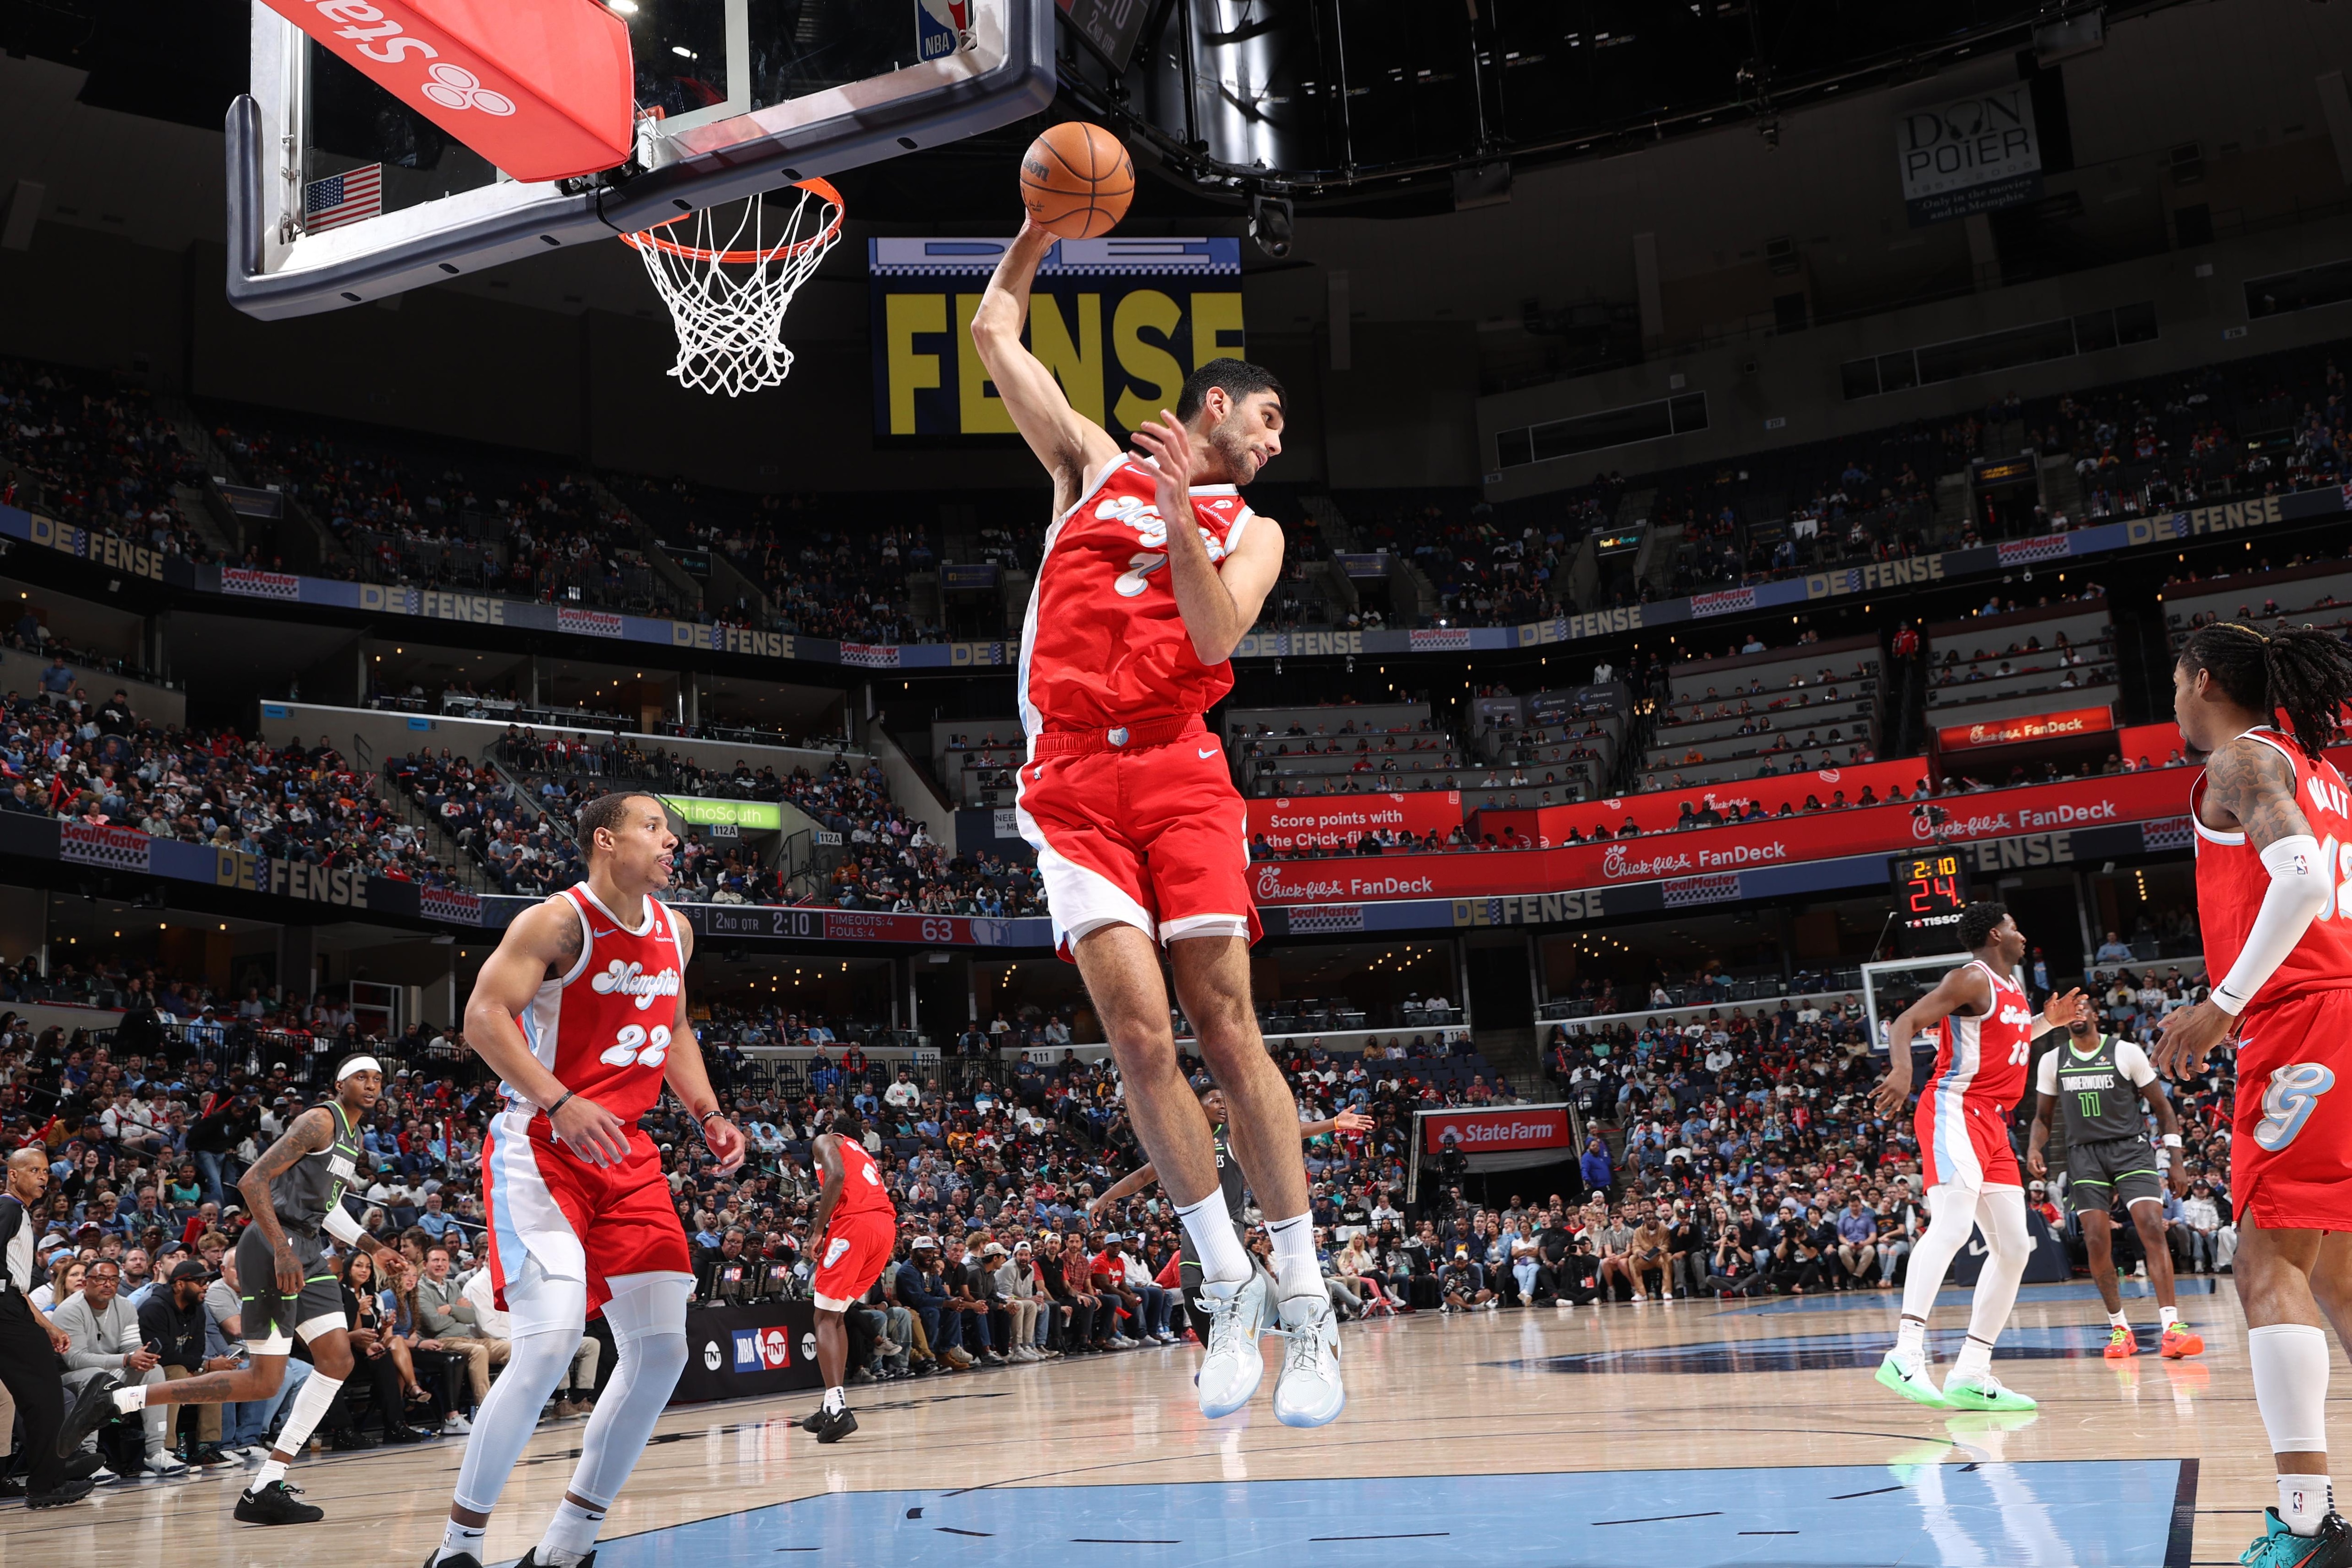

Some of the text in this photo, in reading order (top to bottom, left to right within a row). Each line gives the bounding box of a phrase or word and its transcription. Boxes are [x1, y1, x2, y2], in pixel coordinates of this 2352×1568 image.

[306, 0, 437, 63] Sta
[925, 37, 950, 56] NBA
[1953, 194, 1966, 203] in
[1967, 188, 1986, 200] the
[1989, 179, 2032, 195] movies
[1930, 208, 1952, 220] and
[1954, 205, 1967, 214] in
[1198, 503, 1231, 527] Robinhood
[2127, 496, 2283, 546] DE FENSE
[30, 515, 164, 581] DE FENSE
[1999, 536, 2067, 554] SealMaster
[1113, 552, 1168, 597] 7
[1806, 554, 1945, 599] DE FENSE
[222, 566, 504, 625] SealMaster DE FENSE
[1692, 587, 1754, 606] SealMaster
[558, 607, 795, 658] SealMaster DE FENSE
[1411, 629, 1468, 641] SealMaster
[1518, 606, 1643, 647] DE FENSE
[841, 643, 898, 656] SealMaster
[950, 643, 992, 667] DE
[1240, 631, 1363, 657] DE FENSE
[2025, 718, 2082, 736] FanDeck
[995, 813, 1016, 822] NEE
[1271, 810, 1403, 829] Score points with
[2019, 800, 2116, 827] FanDeck
[62, 822, 150, 851] SealMaster
[714, 825, 737, 836] 112A
[820, 833, 841, 844] 112A
[1266, 835, 1292, 847] the
[1603, 841, 1787, 879] Chick-fil-A FanDeck
[1913, 856, 1957, 879] 2:10
[216, 849, 368, 908] DE FENSE
[1257, 866, 1433, 900] Chick-fil-A FanDeck
[1663, 875, 1737, 893] SealMaster
[421, 885, 481, 908] SealMaster
[1908, 876, 1958, 912] 24
[694, 908, 701, 919] 5
[829, 914, 894, 927] TIMEOUTS: 4
[1289, 905, 1362, 919] SealMaster
[1453, 891, 1605, 927] DE FENSE
[715, 912, 810, 935] 2ND QTR 2:10
[830, 927, 875, 938] FOULS: 4
[921, 918, 953, 941] 63
[599, 1023, 672, 1069] 22
[1033, 1052, 1049, 1062] 111
[2008, 1040, 2030, 1067] 13
[921, 1053, 935, 1064] 112
[2060, 1074, 2115, 1092] TIMBERWOLVES
[2077, 1091, 2101, 1117] 11
[736, 1338, 787, 1364] NBA TNT
